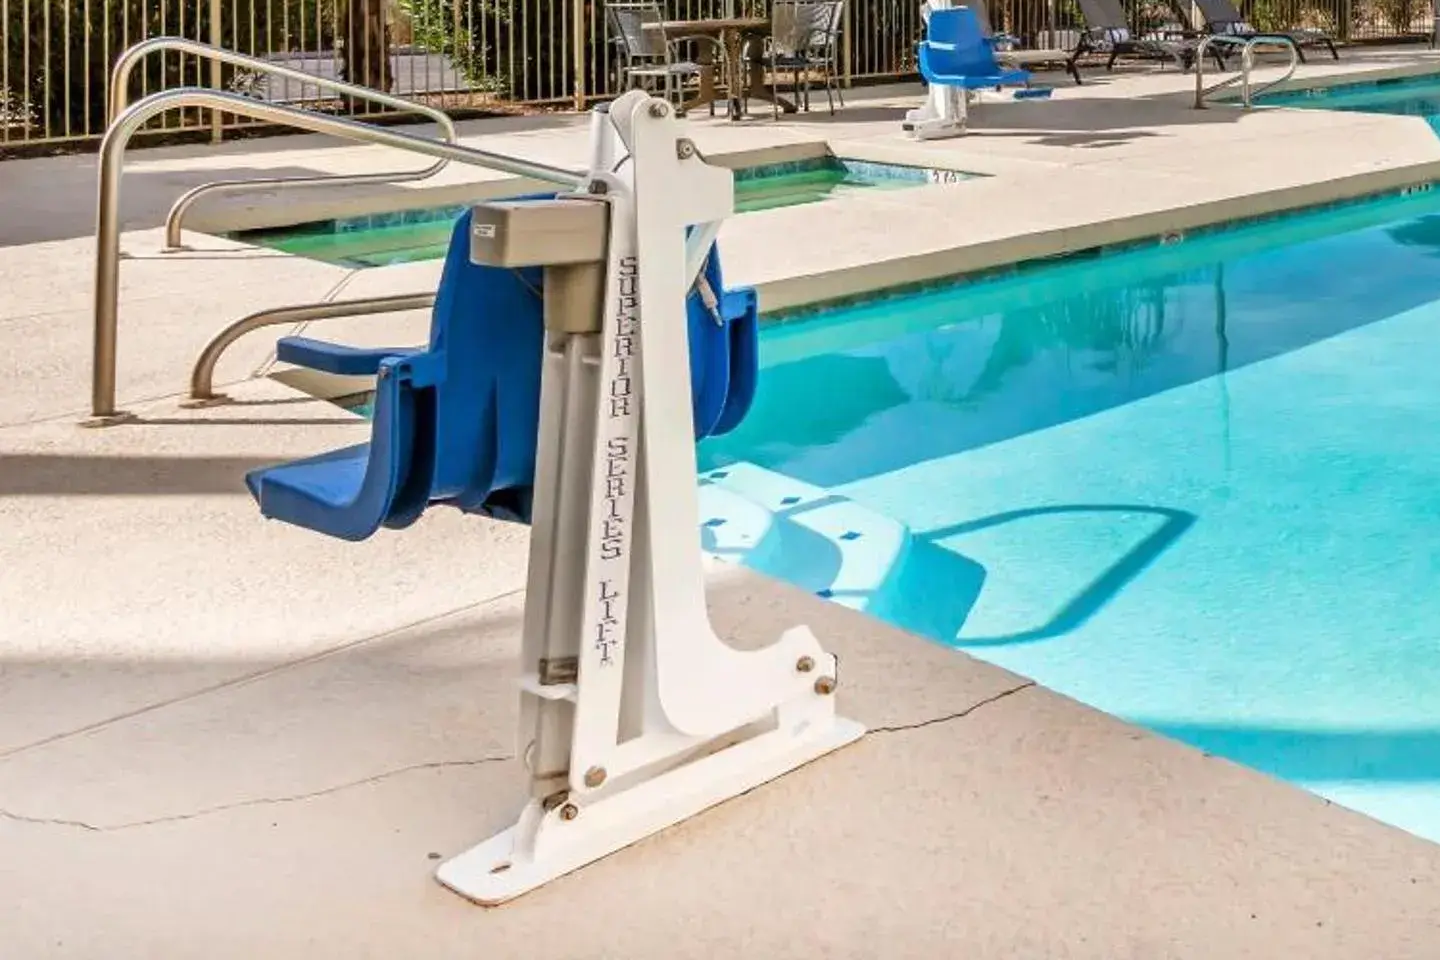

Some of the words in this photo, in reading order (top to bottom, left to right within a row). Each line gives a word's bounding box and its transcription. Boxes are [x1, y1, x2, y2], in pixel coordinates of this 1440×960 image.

[609, 256, 638, 418] SUPERIOR
[601, 437, 629, 561] SERIES
[596, 580, 619, 669] LIFT
